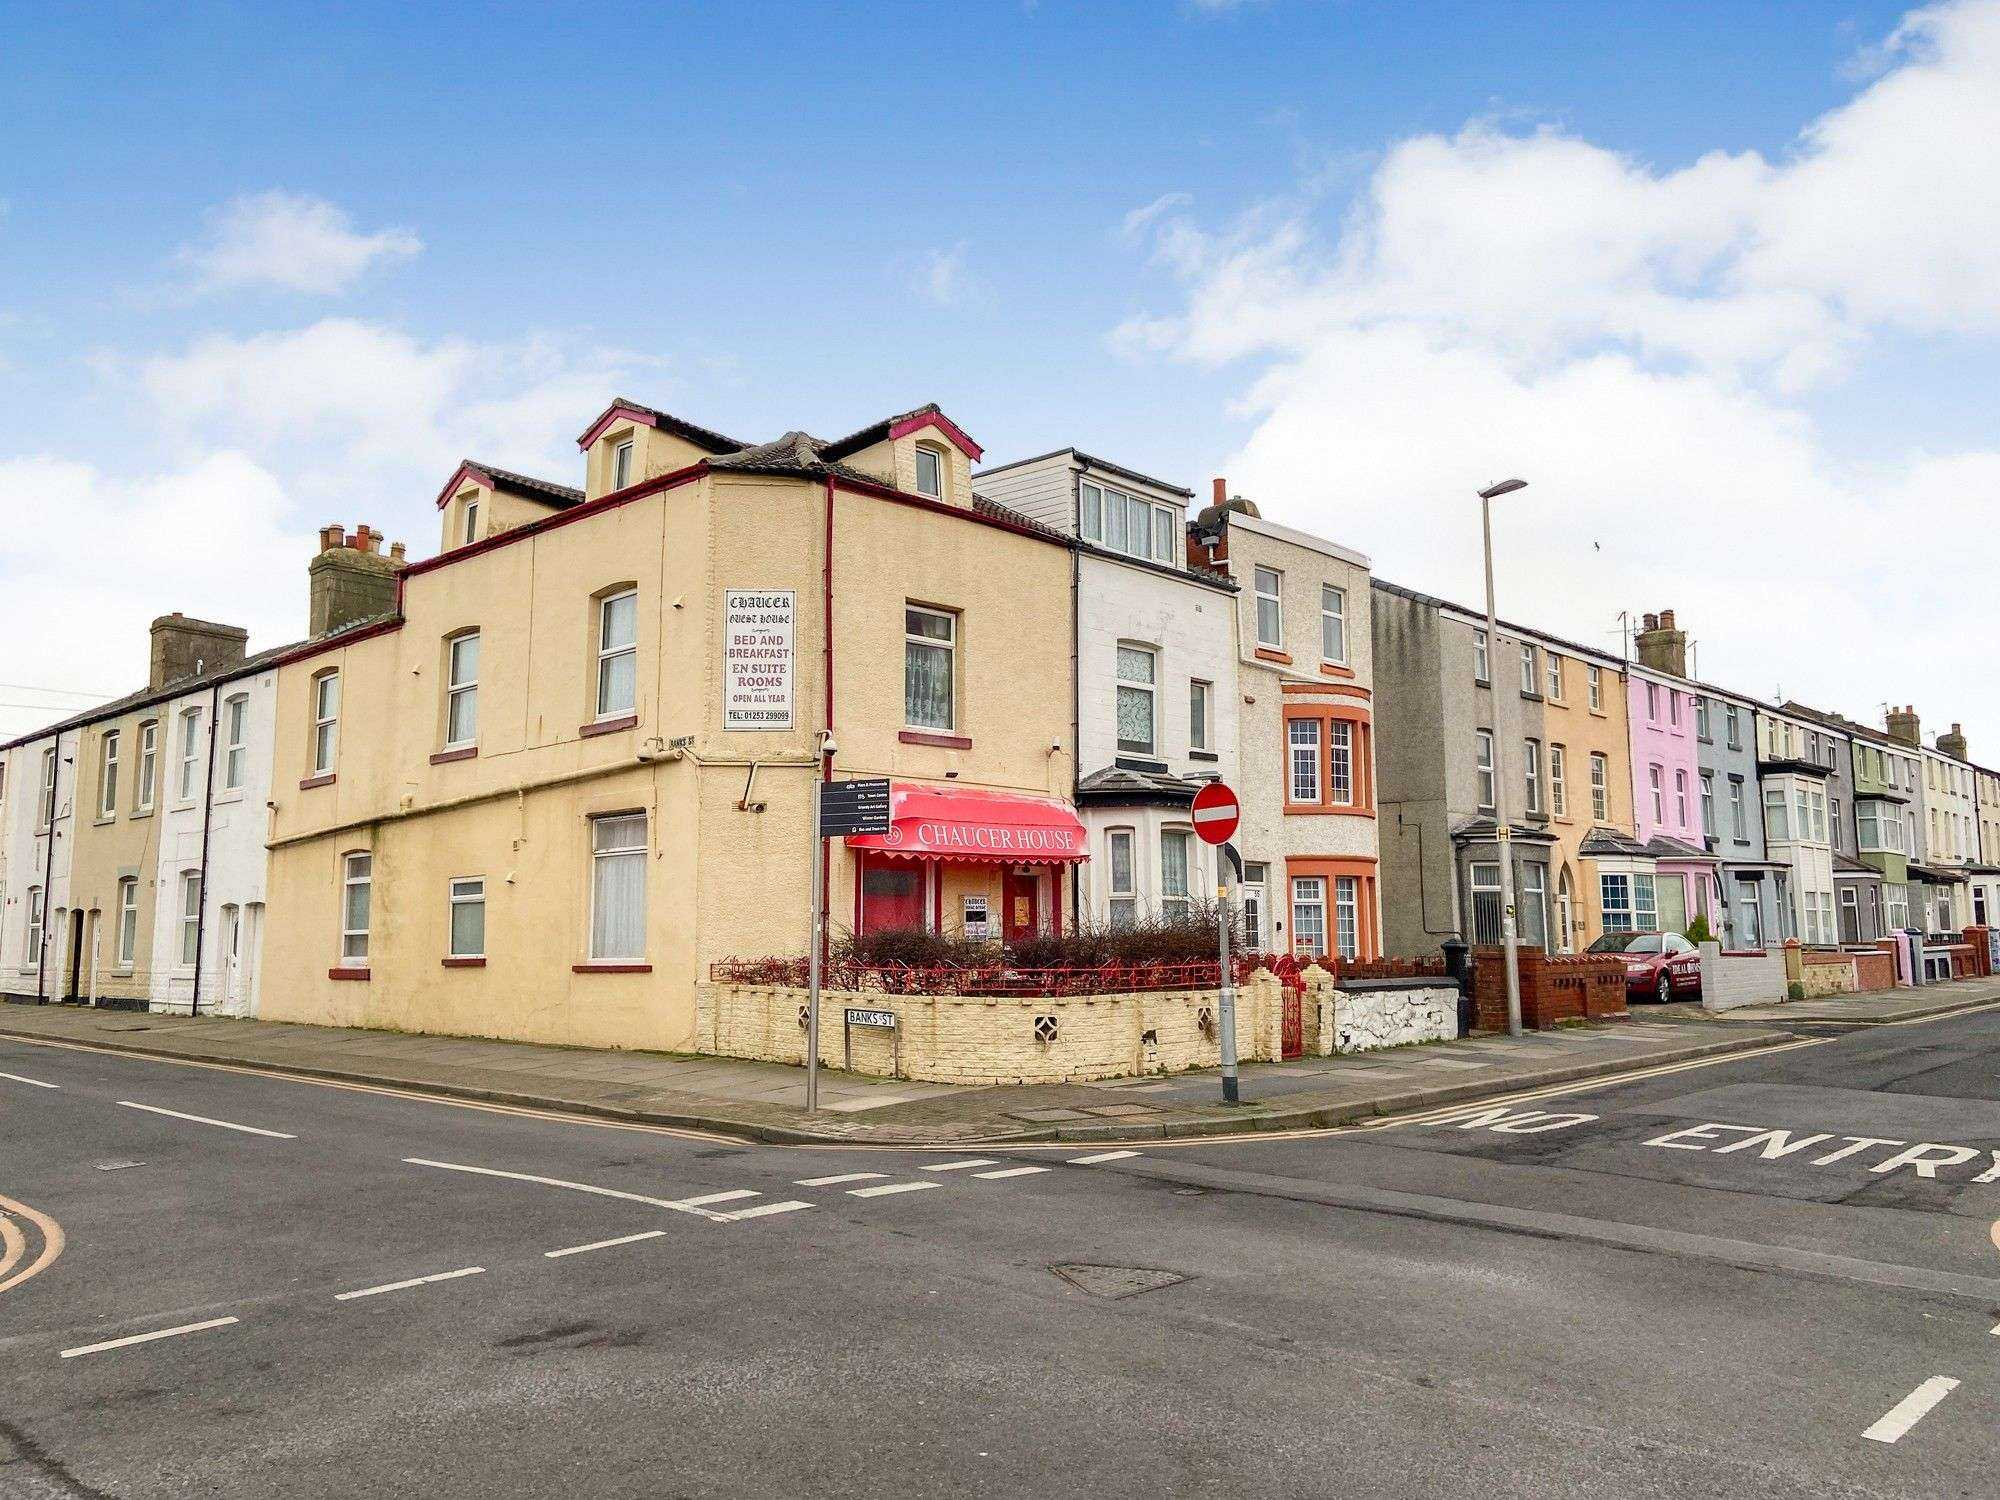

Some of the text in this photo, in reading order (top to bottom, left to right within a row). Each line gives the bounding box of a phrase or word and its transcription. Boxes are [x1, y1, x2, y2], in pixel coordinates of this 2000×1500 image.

[730, 597, 791, 610] CHAUCER
[729, 614, 790, 625] GUEST HOUSE
[734, 635, 784, 646] BED AND
[729, 648, 790, 659] BREAKFAST
[732, 663, 787, 674] EN SUITE
[737, 677, 783, 687] ROOMS
[733, 694, 786, 703] OPEN ALL YEAR
[728, 711, 789, 720] TEL: 01253 299099
[918, 823, 1017, 849] CHAUCER
[1017, 829, 1074, 850] HOUSE
[850, 1010, 893, 1026] BANKS ST
[1419, 1107, 1601, 1135] NO
